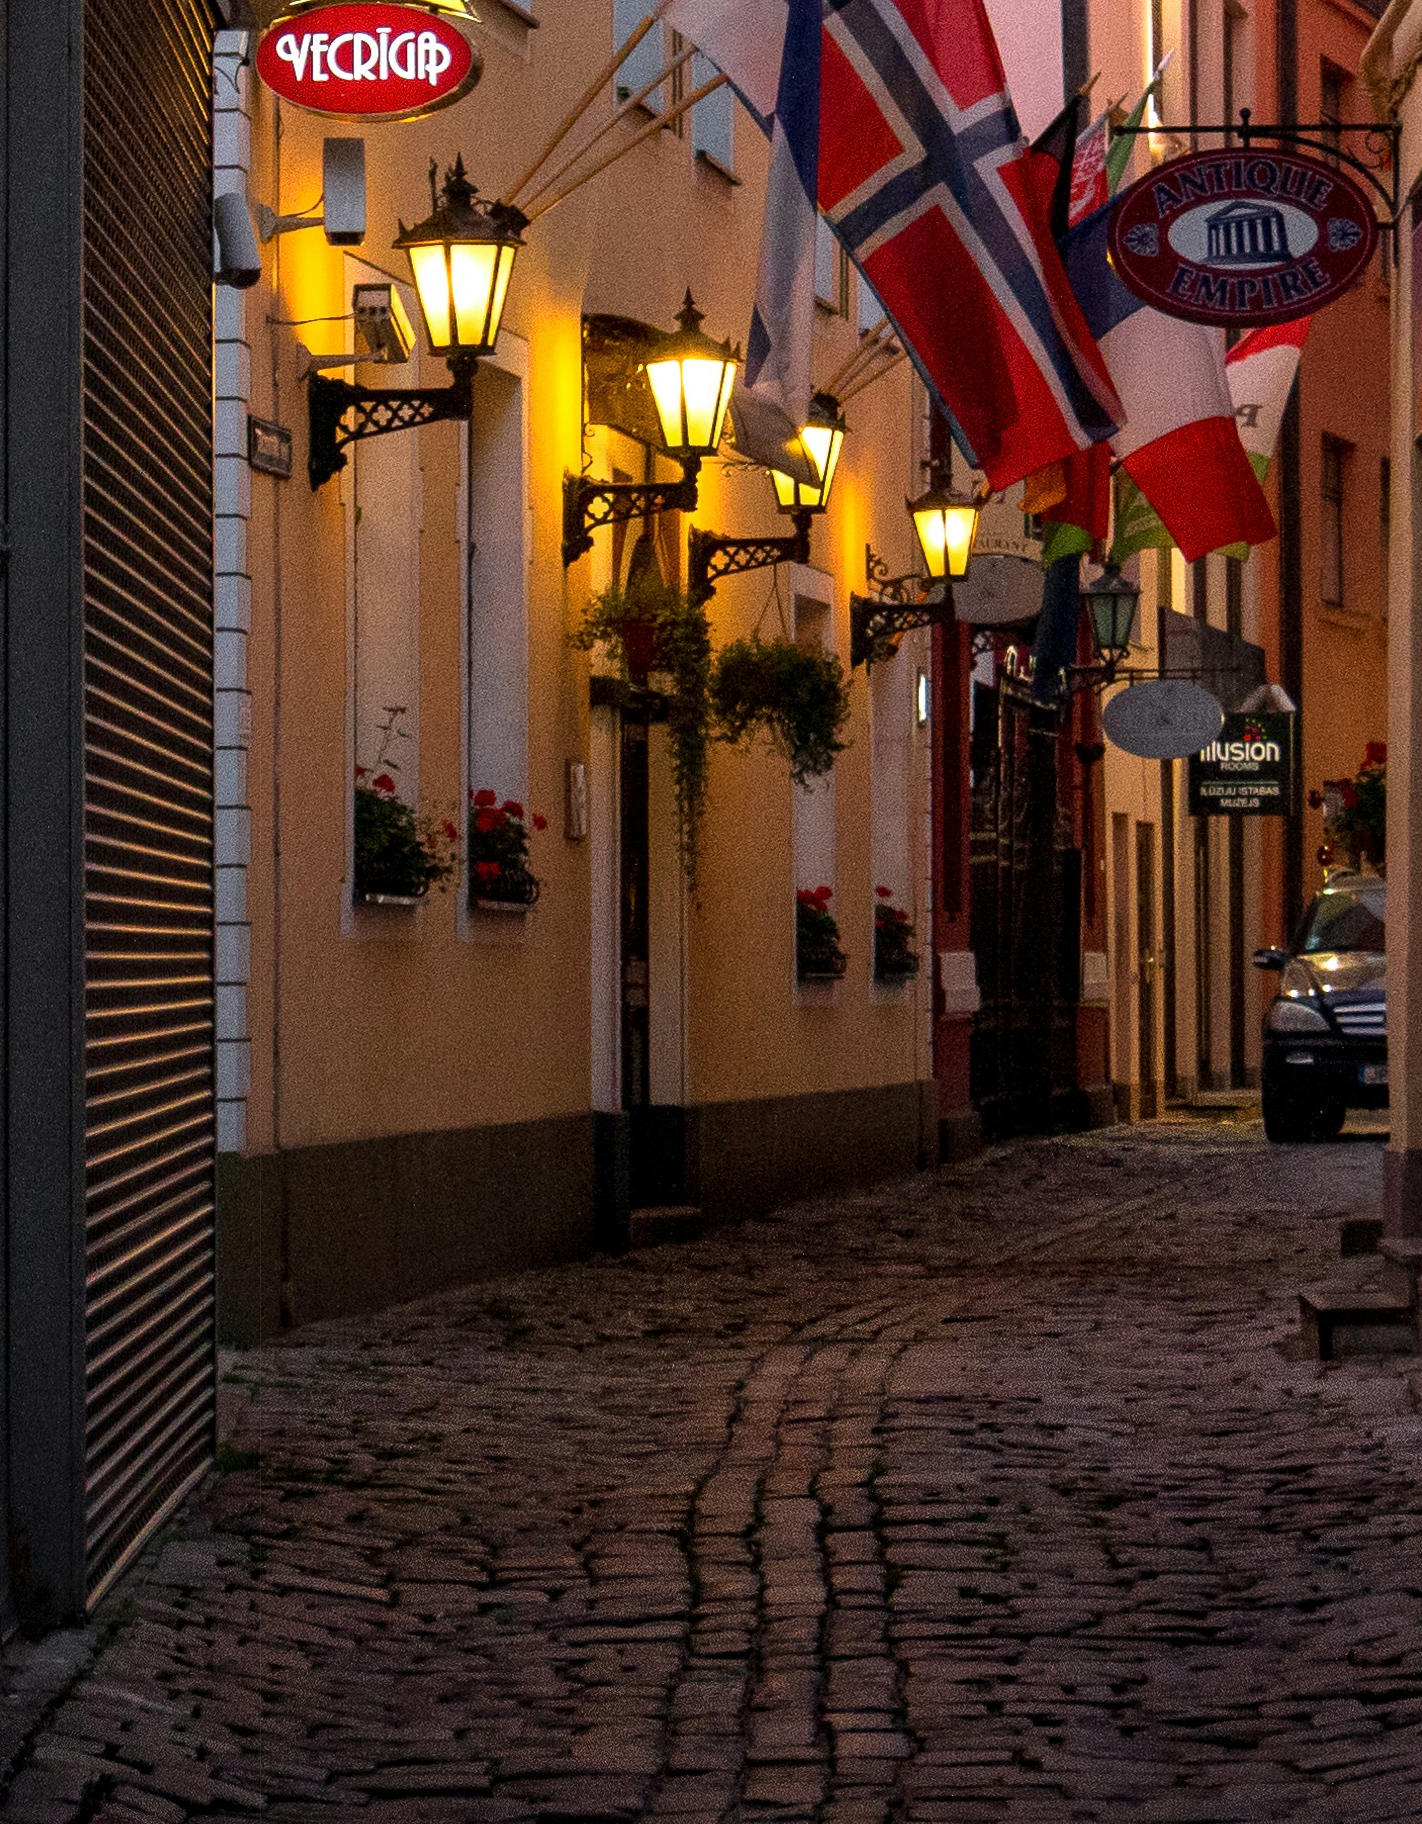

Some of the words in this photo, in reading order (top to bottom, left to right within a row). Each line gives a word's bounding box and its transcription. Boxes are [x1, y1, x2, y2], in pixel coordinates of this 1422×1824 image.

[275, 27, 452, 86] VECRĪGA
[1152, 159, 1334, 218] ANTIQUE
[1166, 256, 1330, 311] EMPIRE
[1220, 762, 1260, 772] ROOMS
